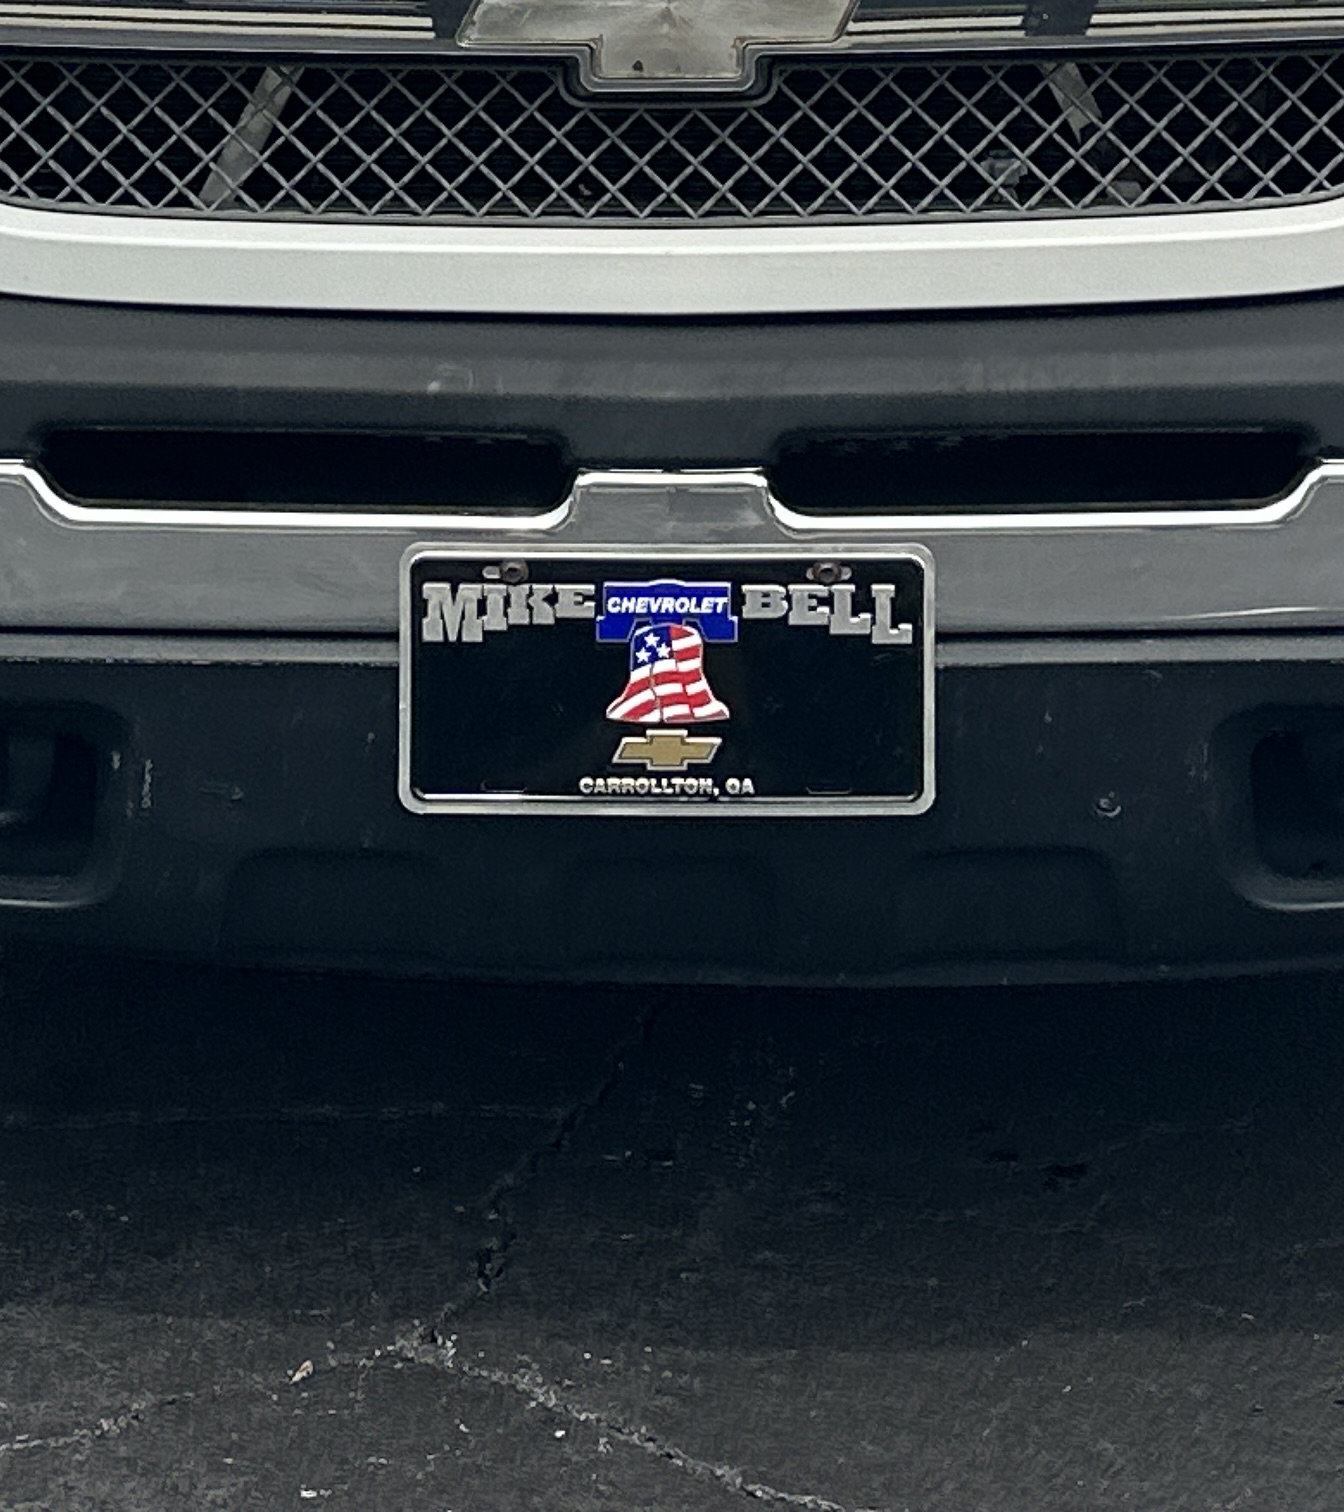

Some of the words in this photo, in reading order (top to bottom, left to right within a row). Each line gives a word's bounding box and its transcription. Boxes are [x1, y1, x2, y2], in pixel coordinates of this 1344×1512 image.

[421, 581, 596, 643] MIKE
[741, 583, 913, 644] BELL
[605, 594, 729, 615] CHEVROLET
[578, 776, 720, 797] CARROLLTON,
